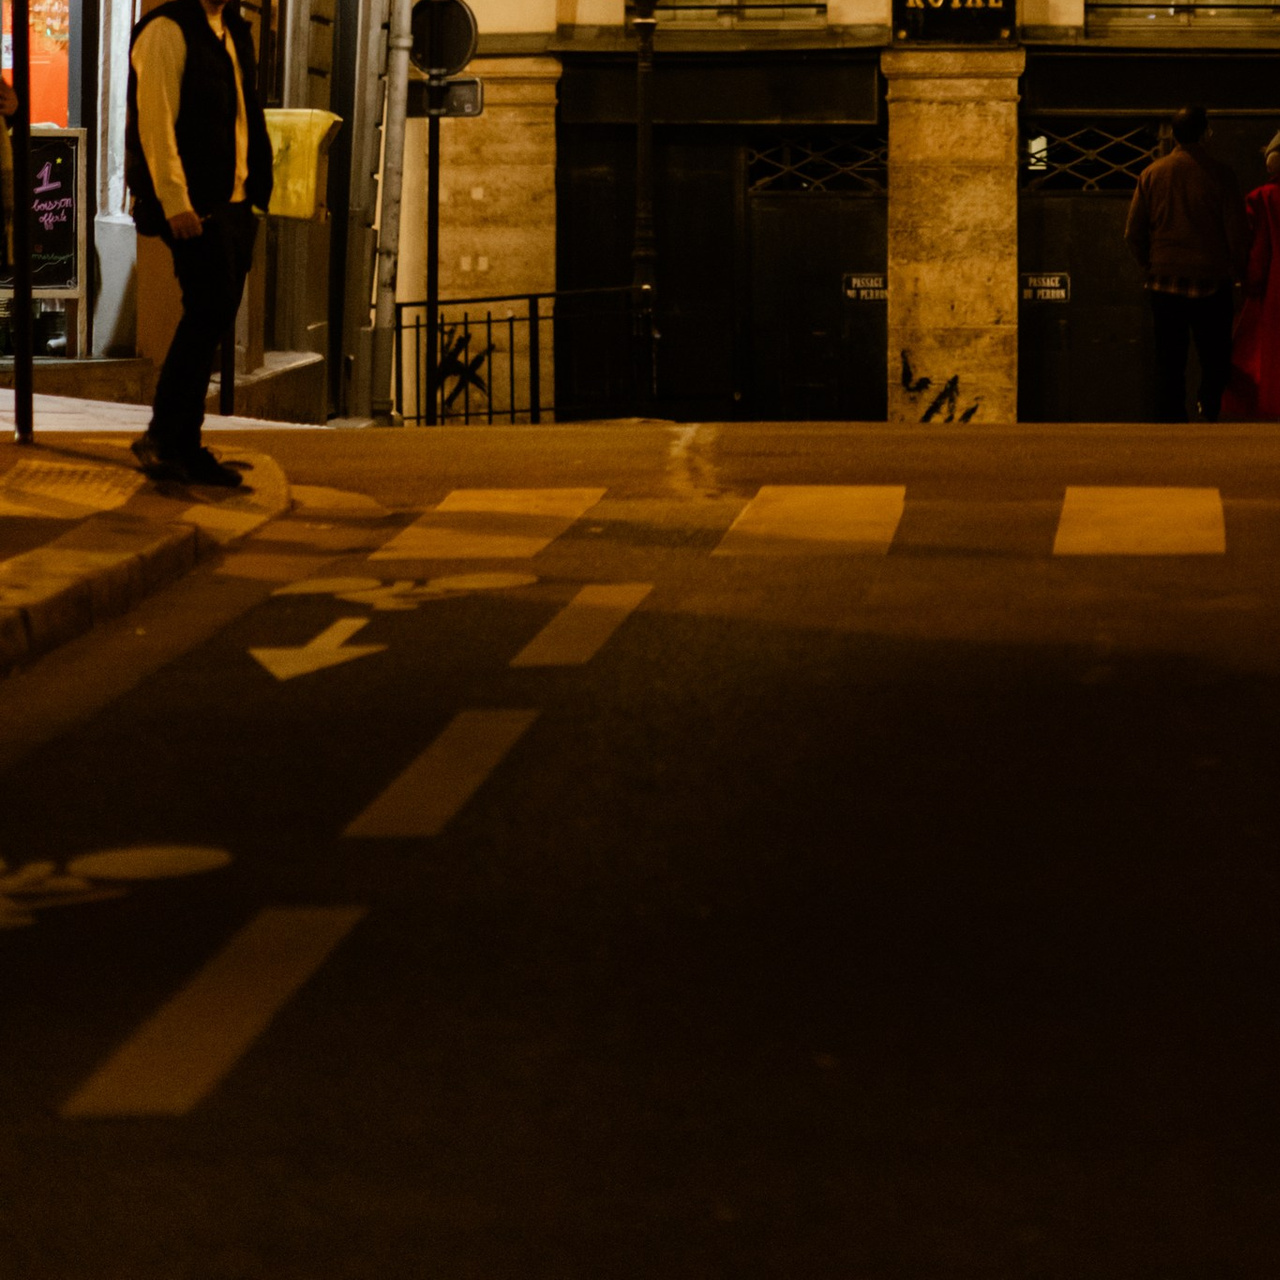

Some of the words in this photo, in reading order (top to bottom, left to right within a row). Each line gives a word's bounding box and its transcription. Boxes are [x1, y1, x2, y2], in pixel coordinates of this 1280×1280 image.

[32, 161, 62, 194] 1
[31, 197, 72, 212] boisson
[851, 276, 883, 288] PASSAGE
[1028, 276, 1060, 287] PASSAGE
